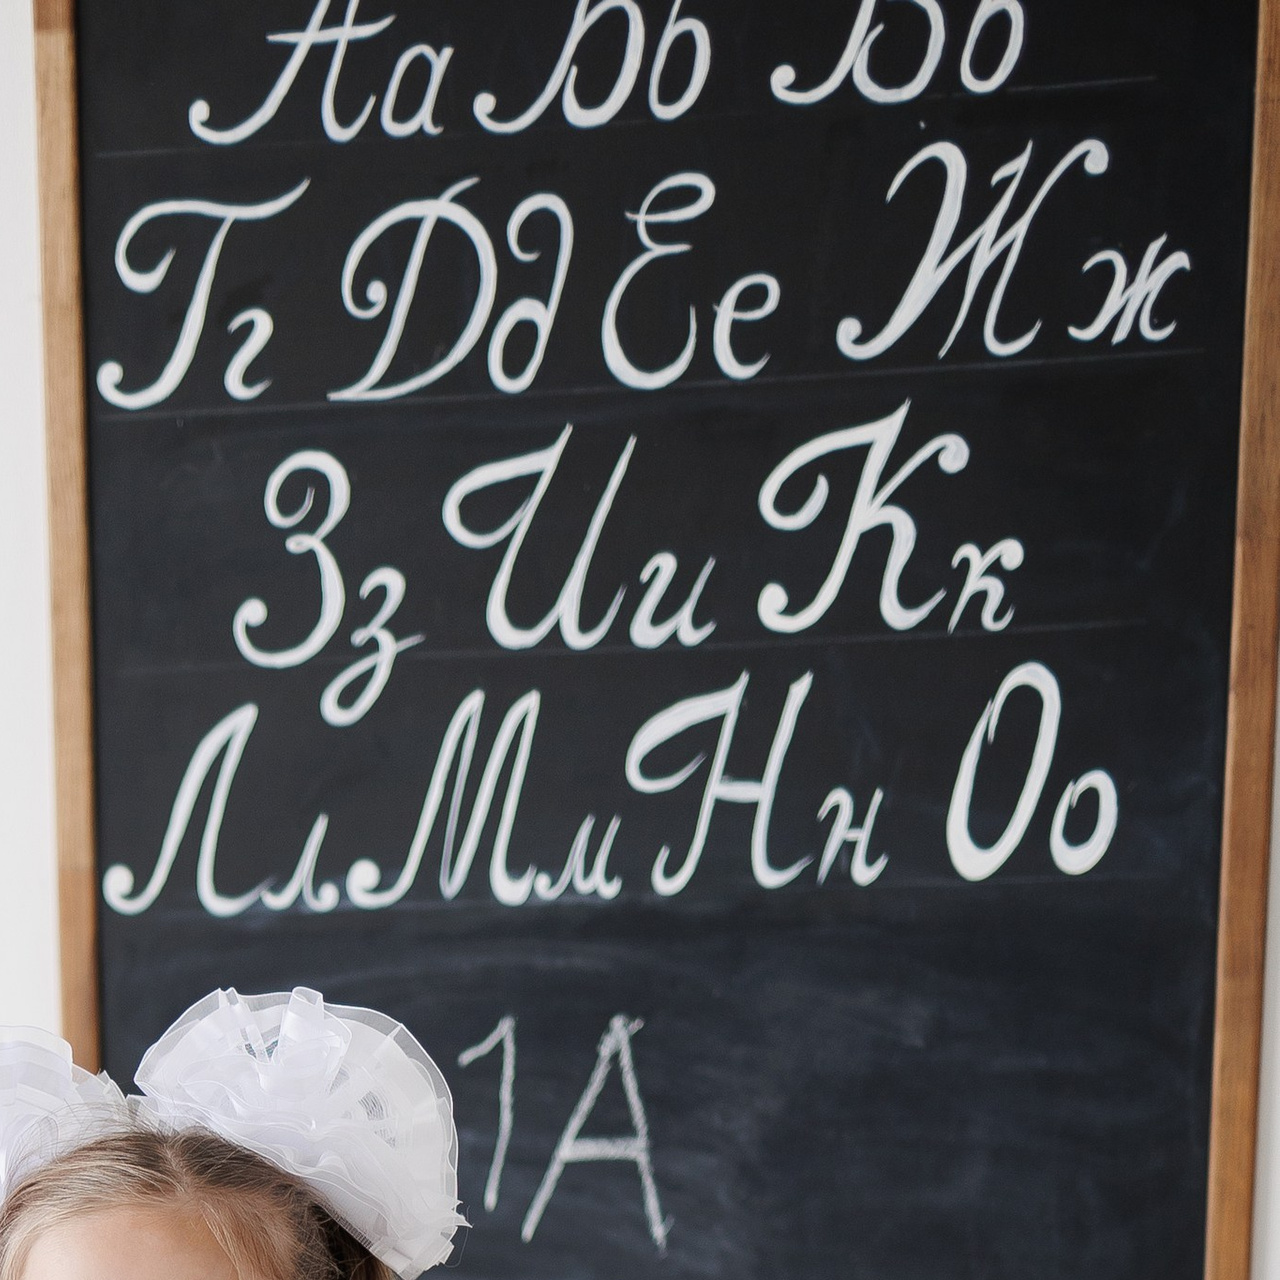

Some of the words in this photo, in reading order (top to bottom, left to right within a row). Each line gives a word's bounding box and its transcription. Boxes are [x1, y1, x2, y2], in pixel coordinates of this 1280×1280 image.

[187, 0, 455, 145] Аа
[326, 176, 575, 402] Дд
[600, 171, 783, 391] Ее
[835, 138, 1192, 361] Жж
[231, 449, 424, 728] Зз
[441, 422, 718, 651] Ии
[756, 397, 1025, 634] Кк
[103, 702, 341, 918] Лл
[347, 688, 624, 910] Мм
[624, 669, 889, 897] Нн
[945, 661, 1119, 883] Оо
